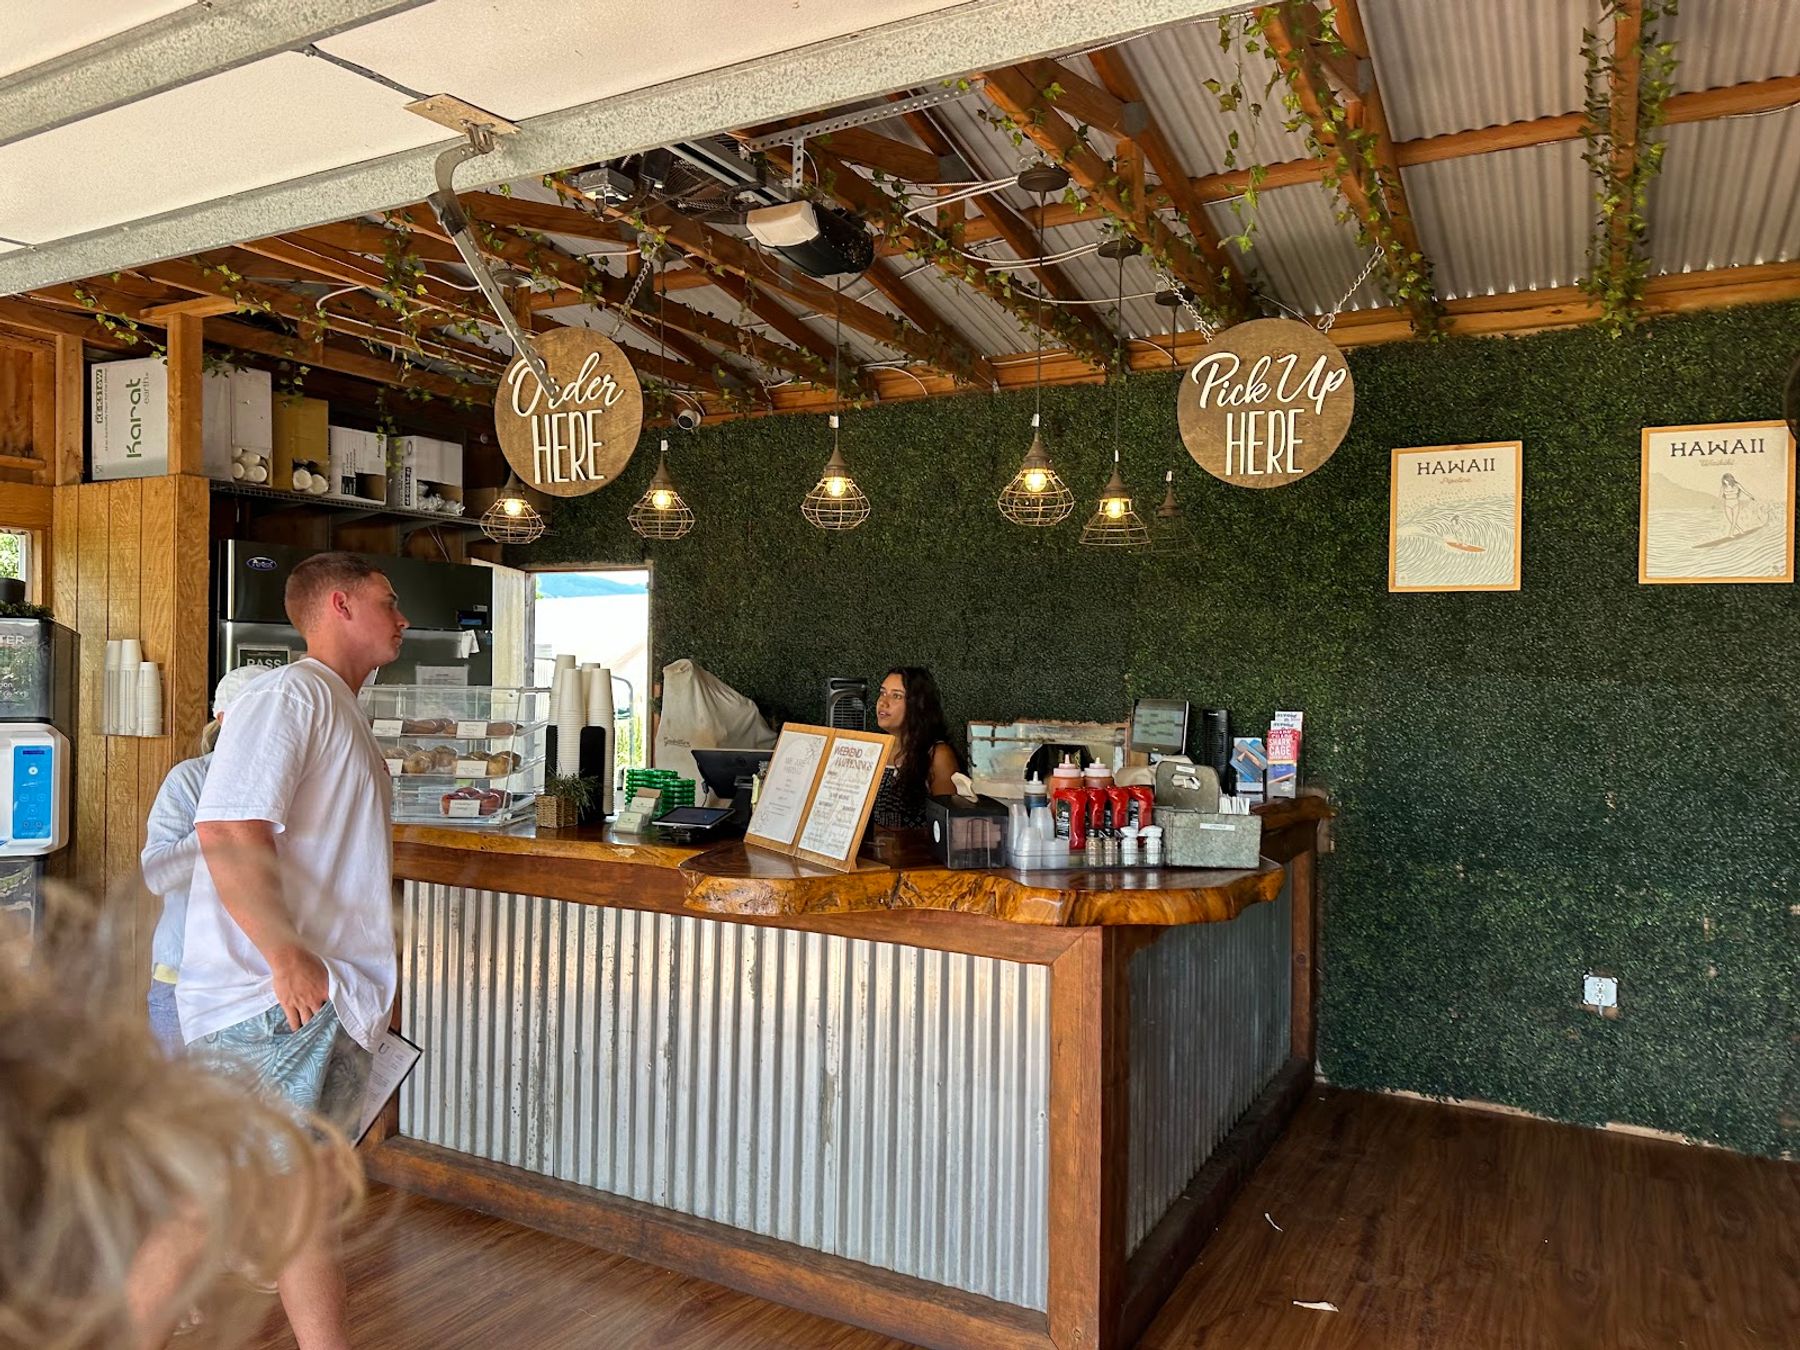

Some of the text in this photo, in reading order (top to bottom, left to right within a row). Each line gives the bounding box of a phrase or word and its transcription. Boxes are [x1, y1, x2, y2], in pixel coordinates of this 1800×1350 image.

[1191, 352, 1347, 415] Pick Up
[125, 377, 142, 458] Karat
[531, 409, 605, 484] HERE
[1225, 408, 1305, 475] HERE
[1670, 437, 1765, 457] HAWAII
[1417, 458, 1495, 475] HAWAII
[1269, 746, 1291, 756] CAGE
